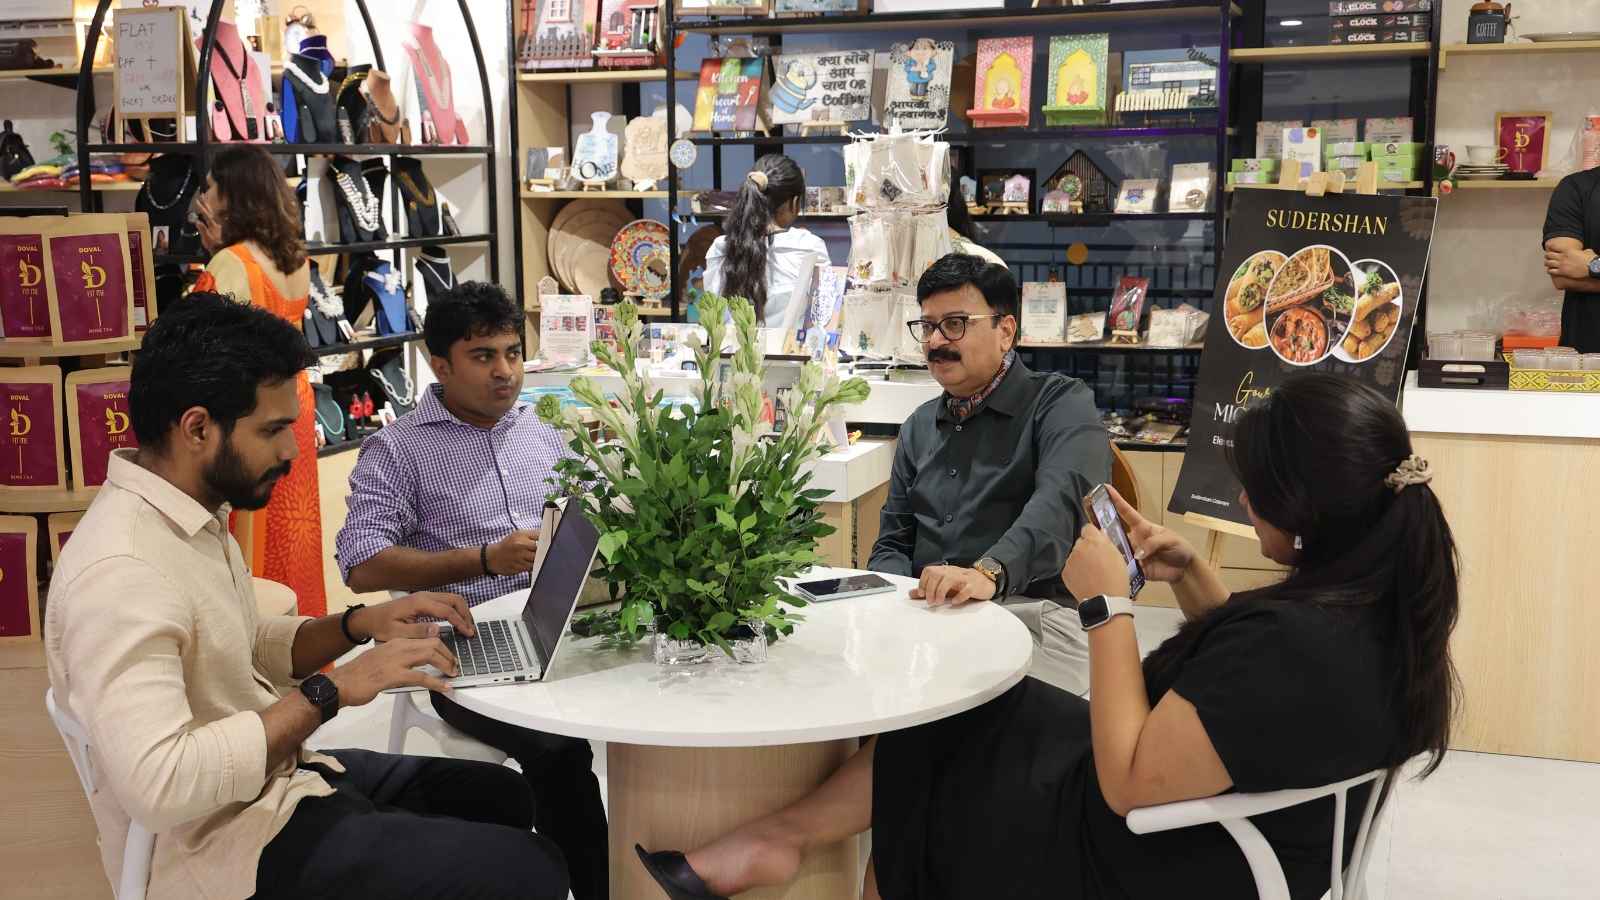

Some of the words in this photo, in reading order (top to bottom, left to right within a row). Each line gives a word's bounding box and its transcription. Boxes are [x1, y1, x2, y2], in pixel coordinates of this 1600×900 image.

[1349, 17, 1378, 27] CLOCK
[119, 22, 156, 37] FLAT
[1476, 22, 1498, 37] COFFEE
[1347, 33, 1376, 42] CLOCK
[816, 55, 842, 67] क्या
[829, 67, 856, 79] आप
[1266, 208, 1389, 236] SUDERSHAN
[78, 246, 103, 254] DOVAL
